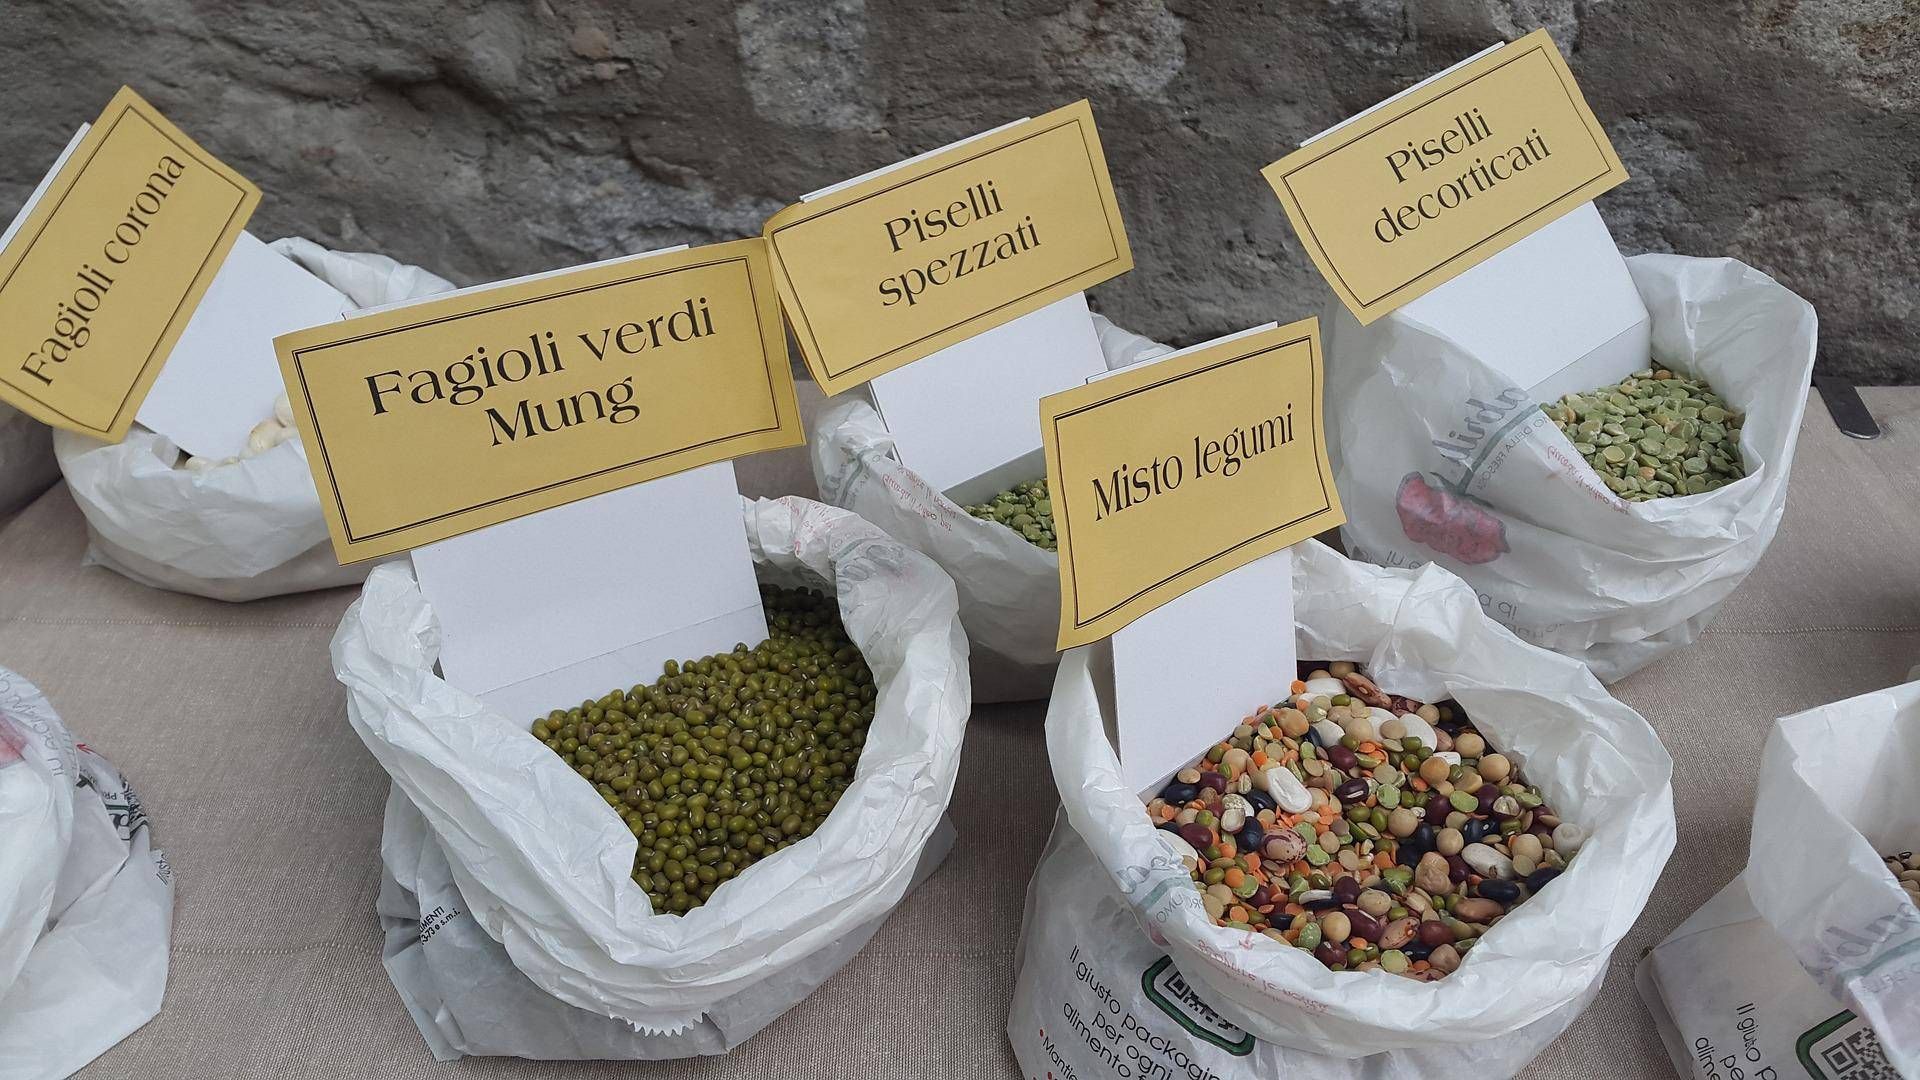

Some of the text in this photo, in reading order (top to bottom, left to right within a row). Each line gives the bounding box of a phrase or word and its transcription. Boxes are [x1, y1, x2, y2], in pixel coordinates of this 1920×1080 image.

[1385, 108, 1493, 184] Piselli
[884, 180, 1004, 253] Piselli
[1375, 129, 1552, 243] decorticati
[20, 155, 186, 387] Fagioli corona
[879, 216, 1042, 307] spezzati
[364, 297, 716, 416] Fagioli verdi
[484, 376, 641, 447] Mung
[1092, 403, 1295, 522] Misto legumi
[1070, 945, 1079, 963] Il
[1076, 962, 1121, 1014] giusto
[1064, 1003, 1131, 1078] alimento
[1092, 1011, 1124, 1045] per
